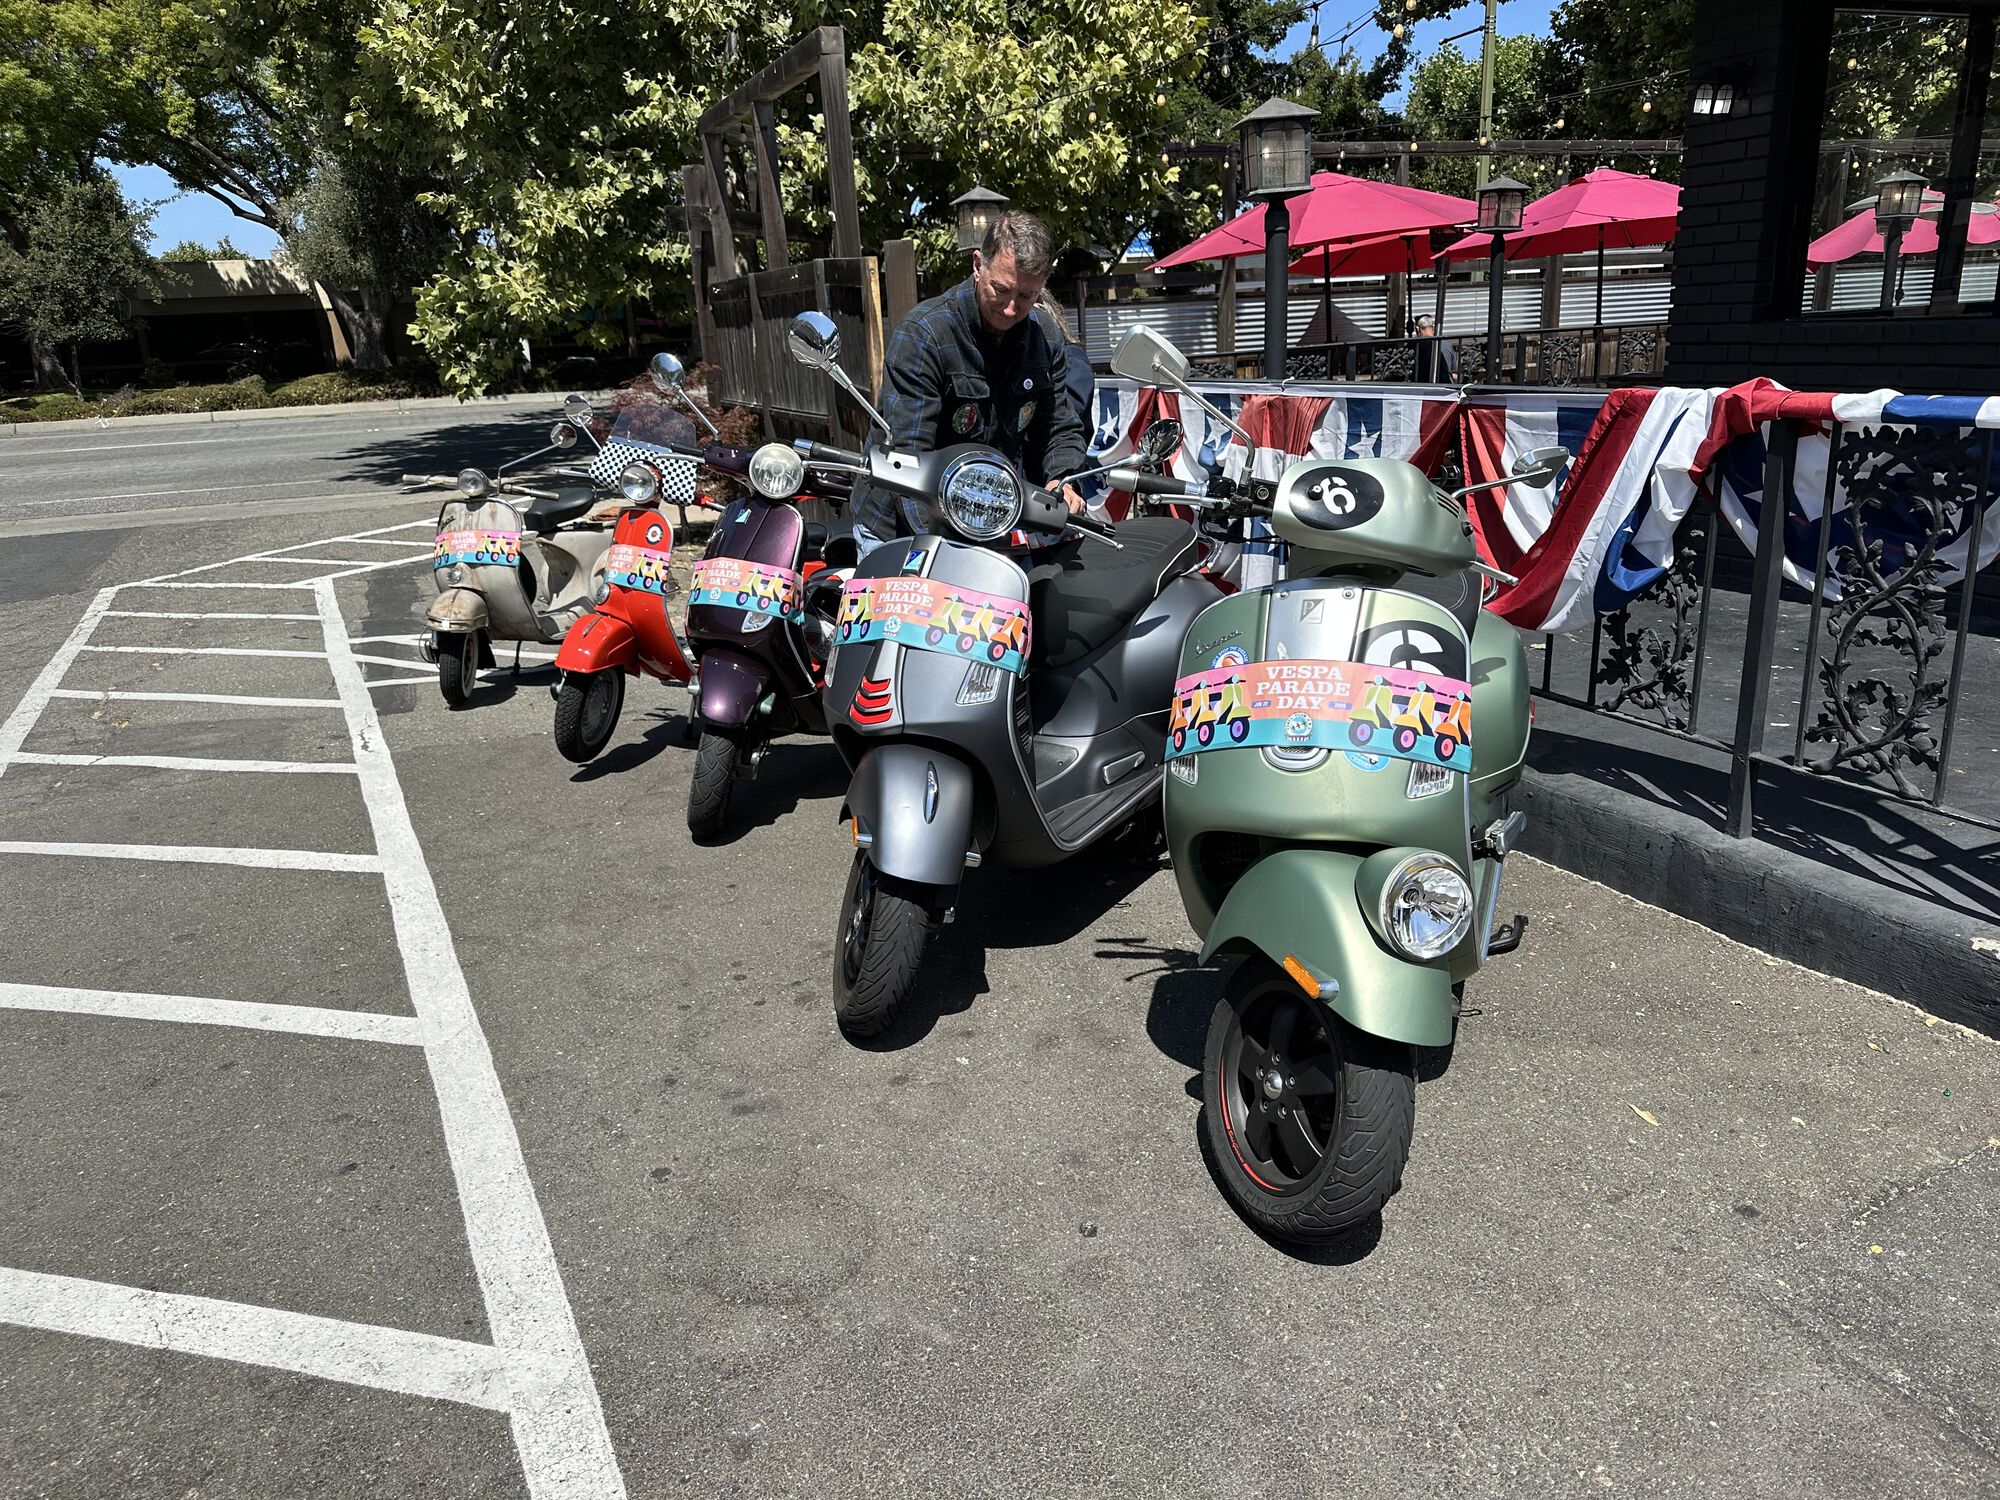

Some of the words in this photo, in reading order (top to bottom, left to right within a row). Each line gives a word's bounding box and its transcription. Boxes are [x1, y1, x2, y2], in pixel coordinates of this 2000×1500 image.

[1319, 476, 1356, 515] 6
[885, 581, 930, 595] VESPA
[878, 591, 934, 608] PARADE
[885, 603, 913, 615] DAY
[1266, 665, 1344, 681] VESPA
[1255, 680, 1351, 698] PARADE
[1276, 695, 1325, 710] DAY
